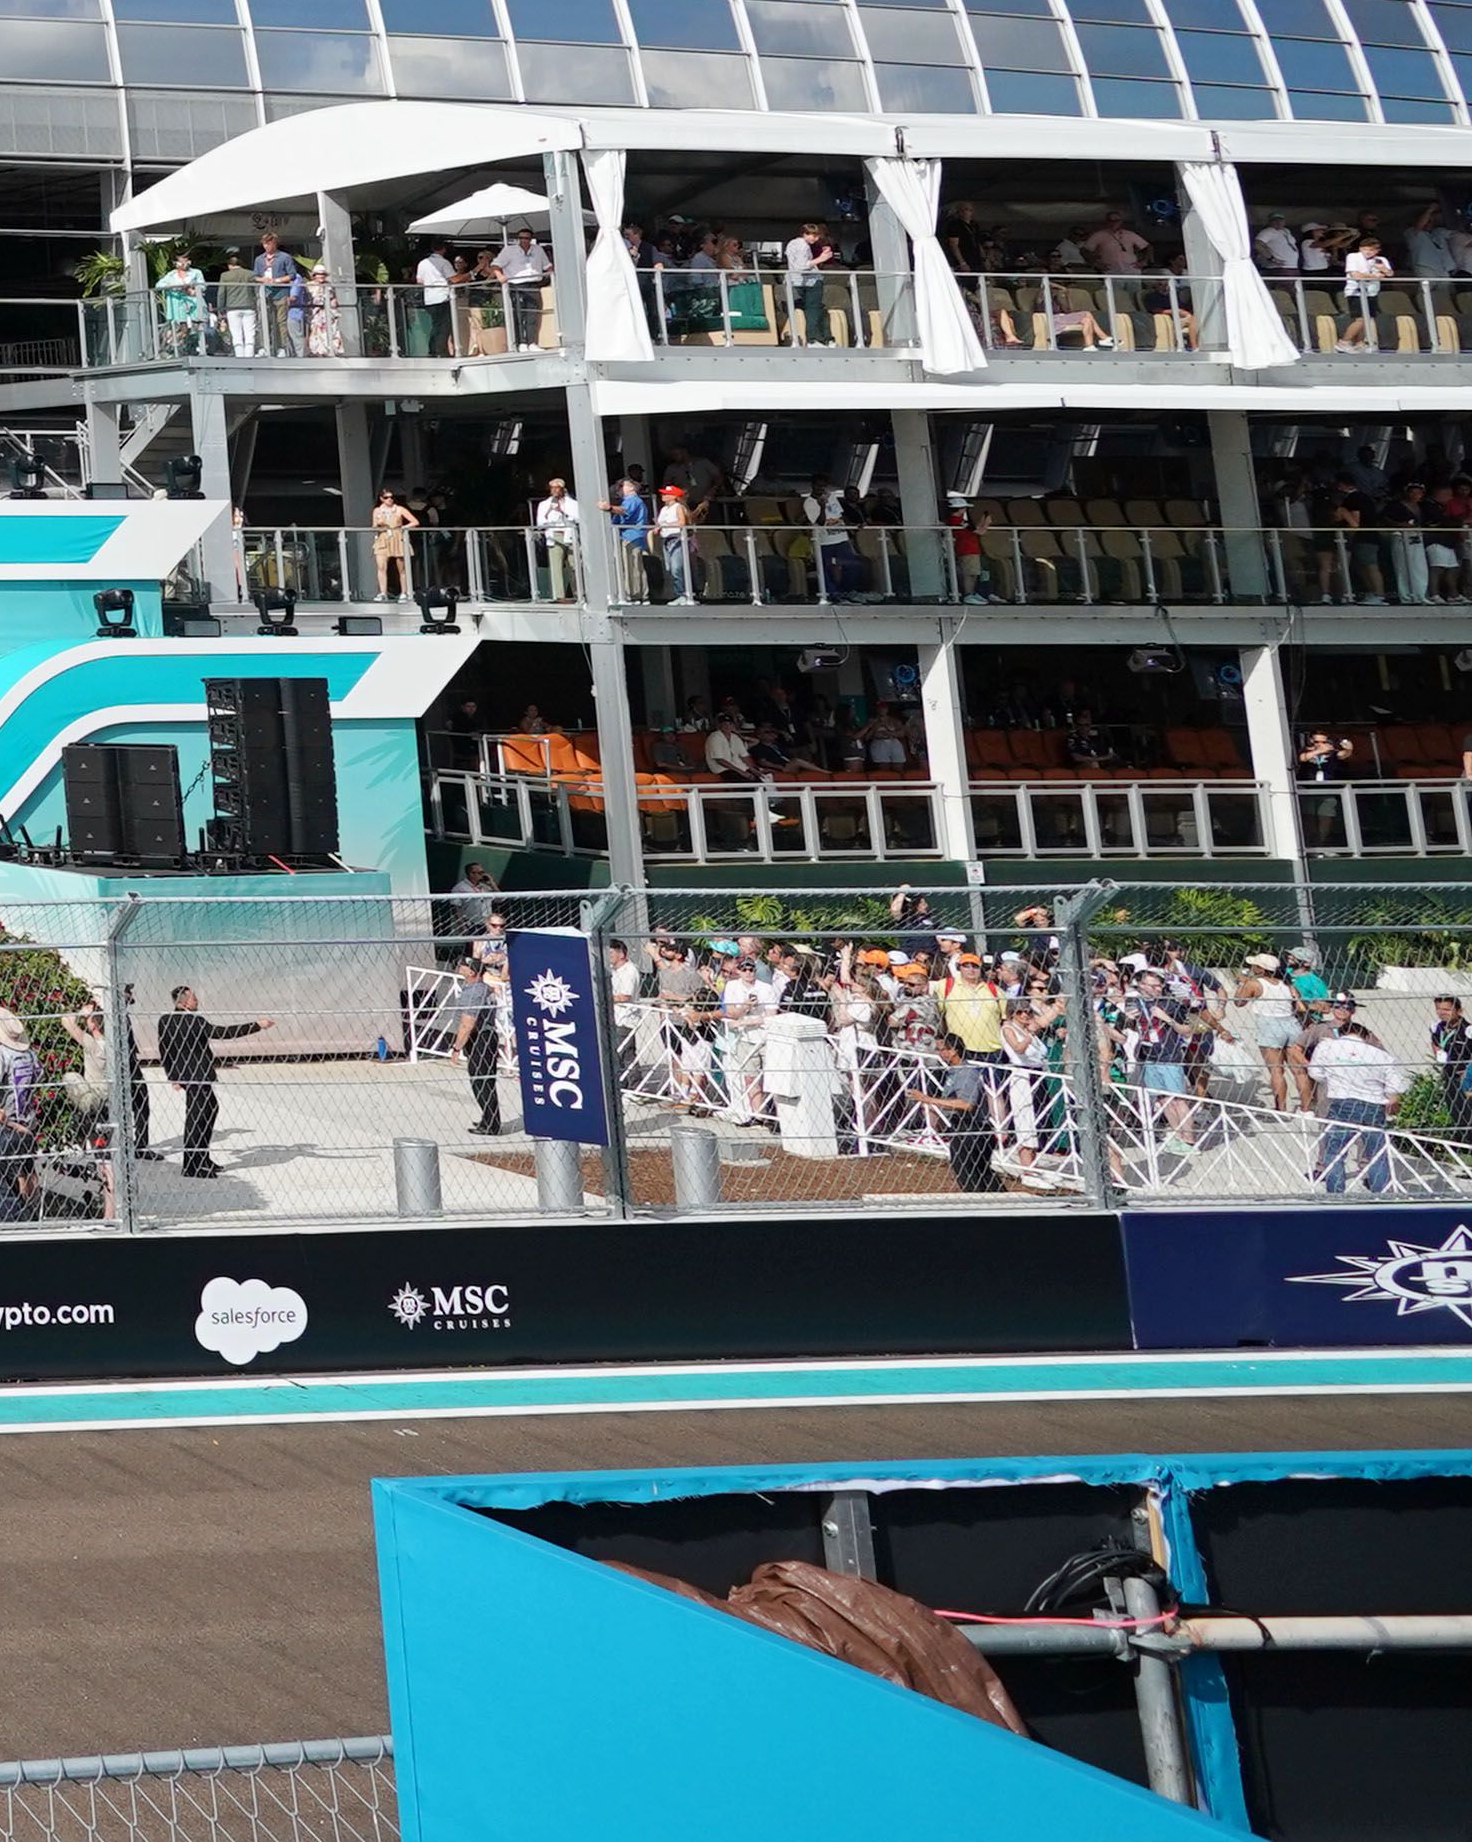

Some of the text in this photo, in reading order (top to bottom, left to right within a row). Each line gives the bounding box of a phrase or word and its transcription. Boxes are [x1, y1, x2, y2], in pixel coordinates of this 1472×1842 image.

[526, 1016, 545, 1106] CRUISES
[543, 1018, 583, 1110] MSC
[430, 1284, 510, 1316] MSC
[211, 1305, 297, 1329] salesforce
[433, 1317, 512, 1330] CRUISES
